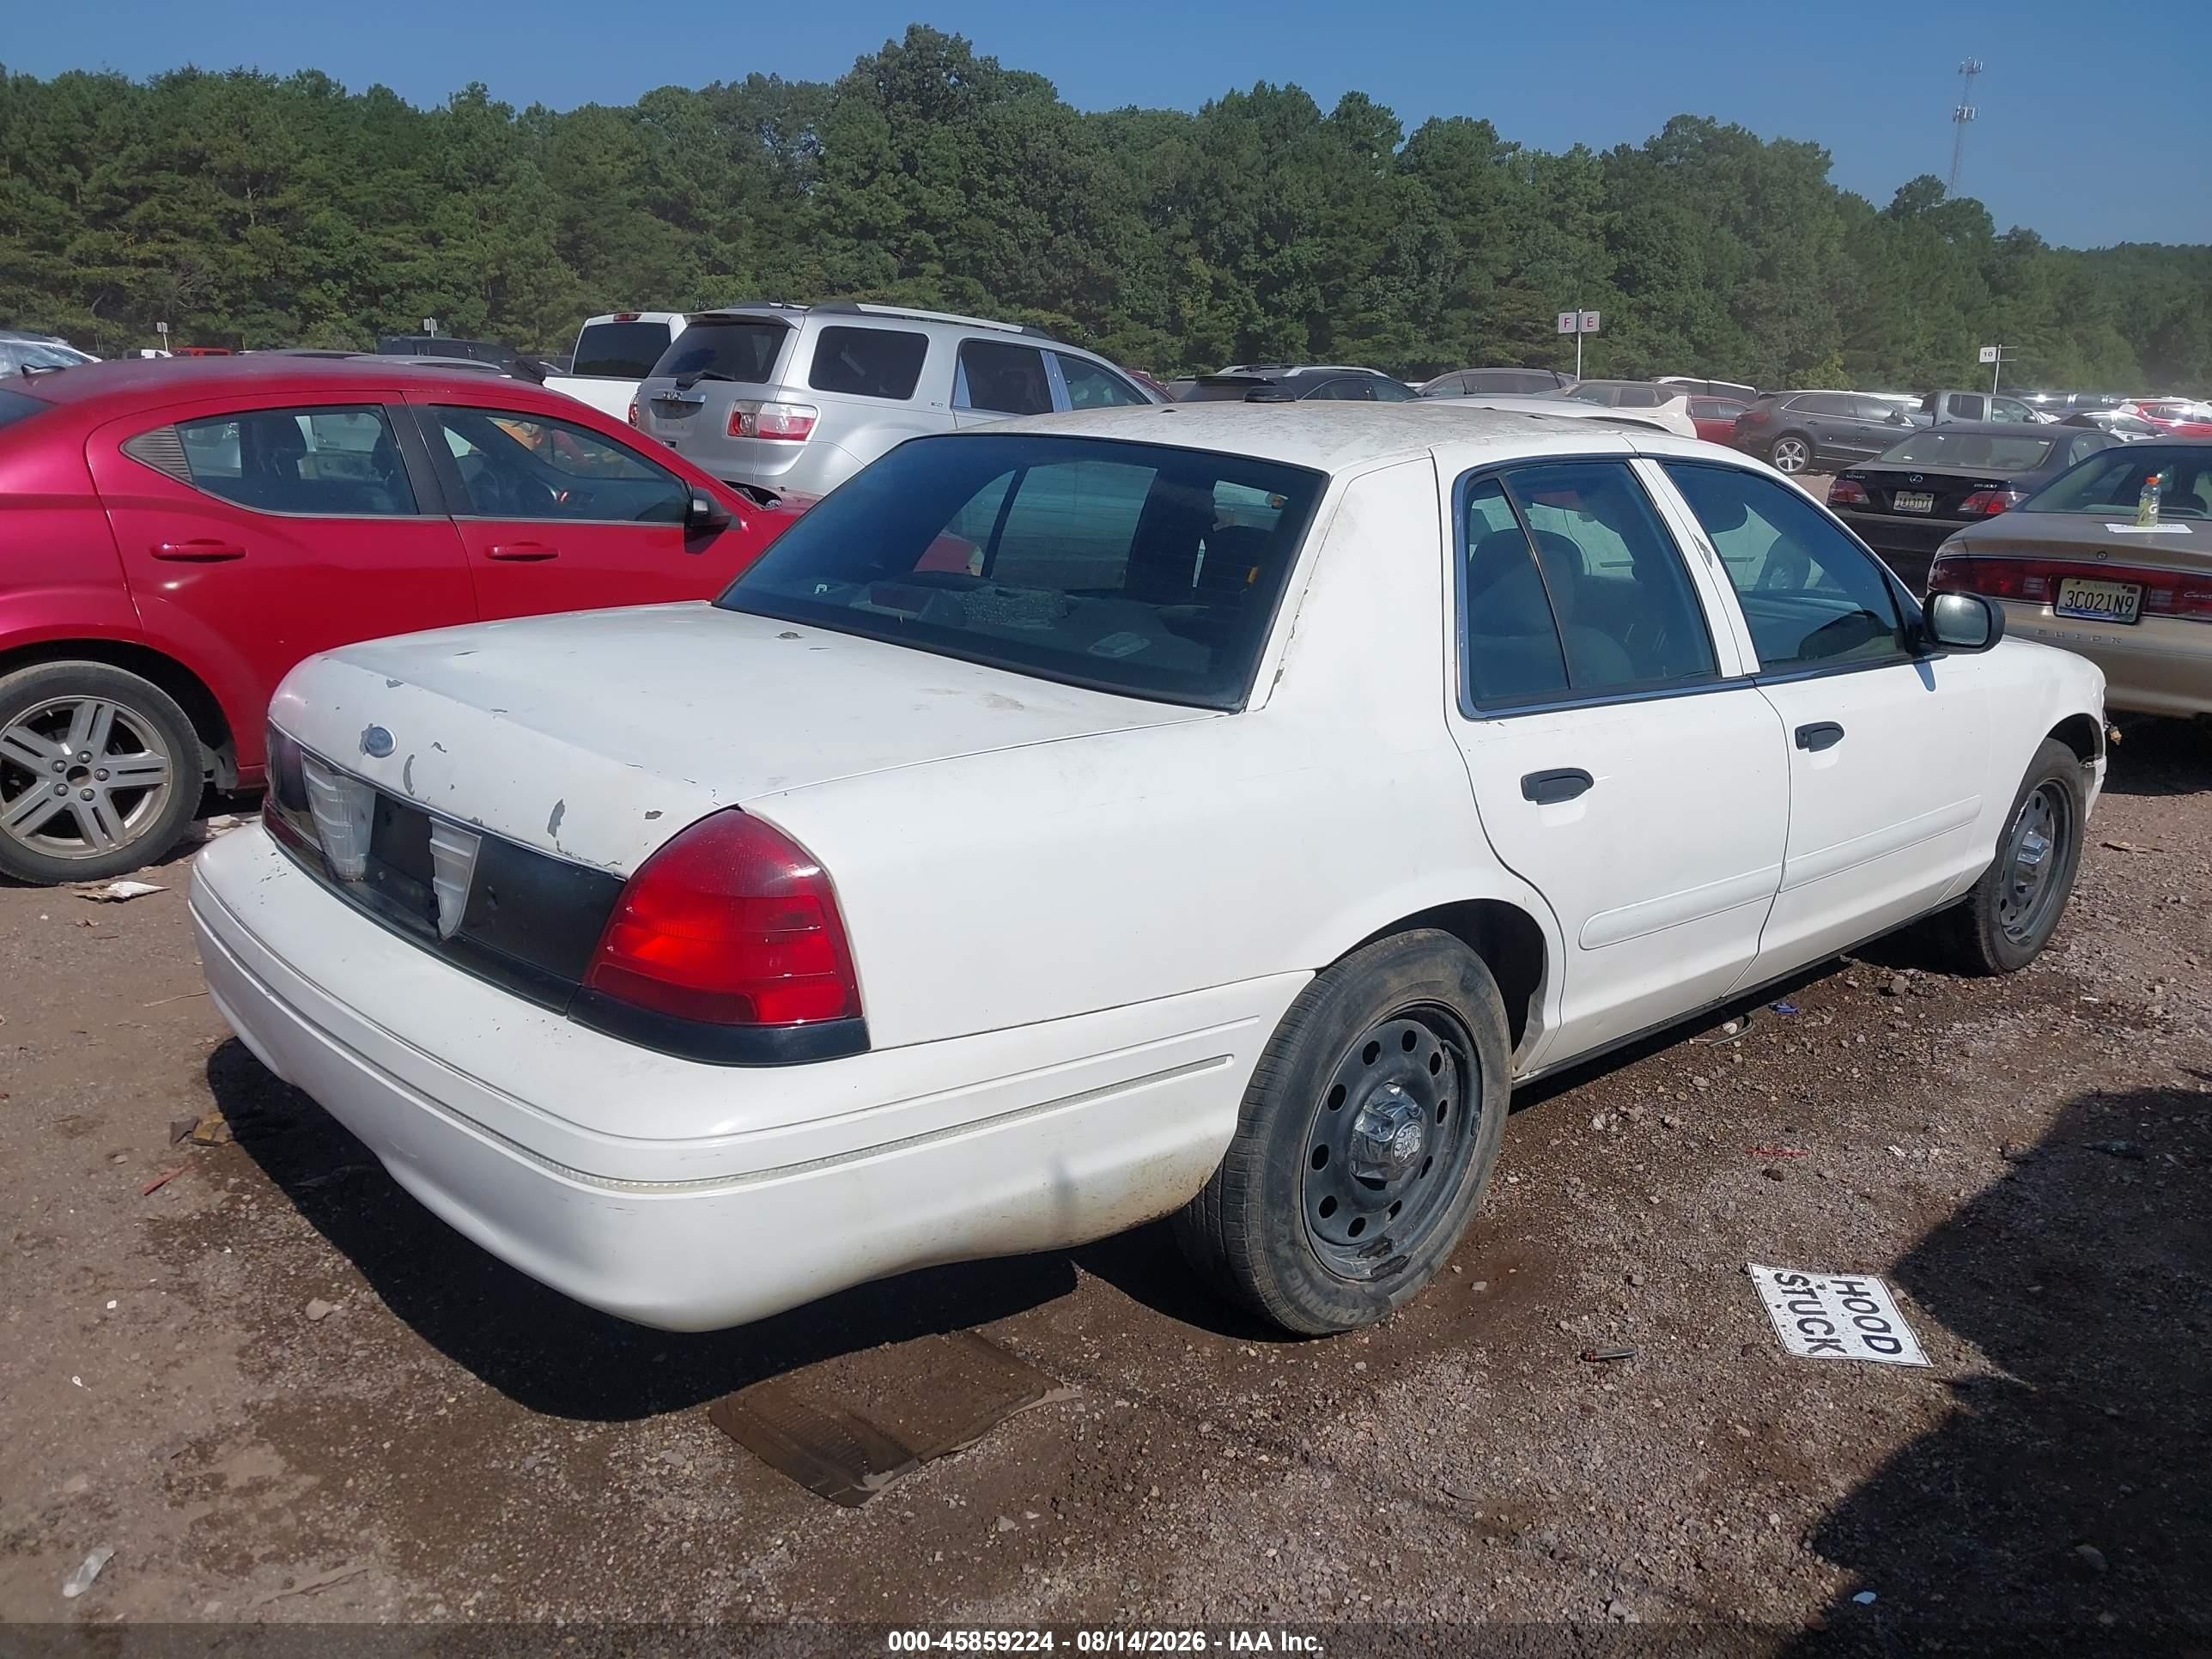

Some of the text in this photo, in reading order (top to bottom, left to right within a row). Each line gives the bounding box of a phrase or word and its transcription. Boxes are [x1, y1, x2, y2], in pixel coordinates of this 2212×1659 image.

[1564, 317, 1571, 328] F
[1587, 317, 1594, 327] E
[2148, 503, 2158, 514] G
[2064, 590, 2135, 613] 3C021N9
[1773, 1272, 1848, 1354] STUCK
[1830, 1279, 1903, 1354] HOOD
